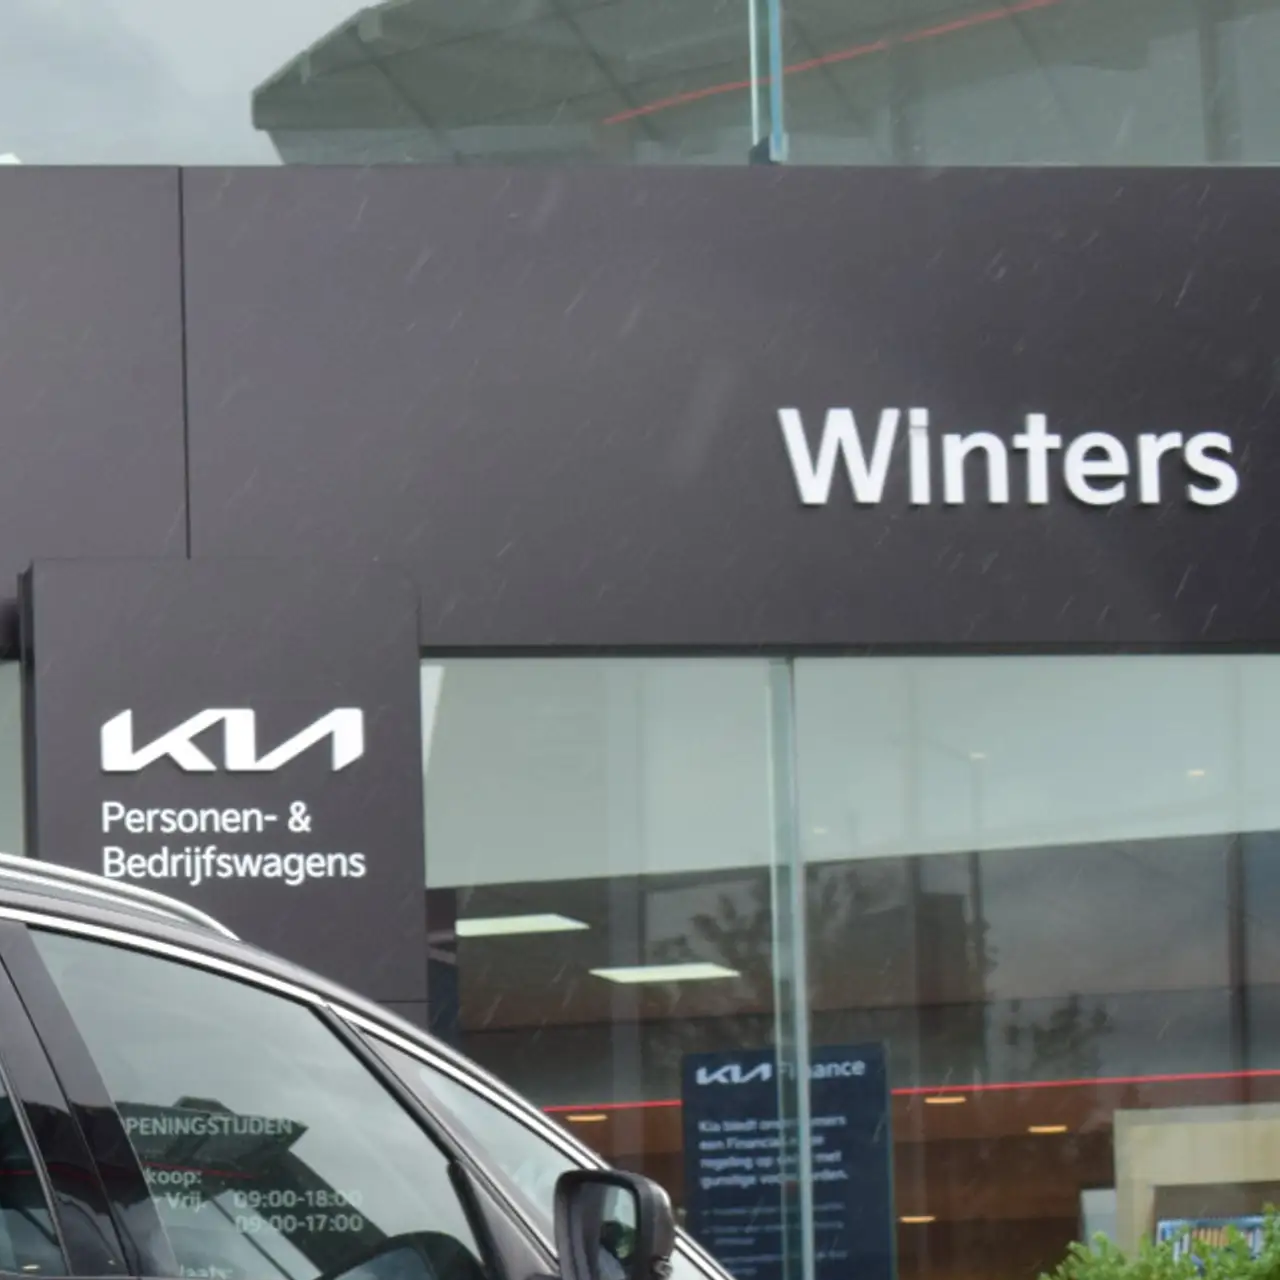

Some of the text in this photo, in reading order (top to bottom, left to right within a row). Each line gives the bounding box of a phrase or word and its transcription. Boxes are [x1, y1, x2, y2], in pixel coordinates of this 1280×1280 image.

[778, 408, 1239, 506] Winters
[101, 708, 364, 772] KIA
[101, 801, 312, 834] Personen- &
[102, 846, 366, 886] Bedrijfswagens
[779, 1060, 866, 1080] Fiance
